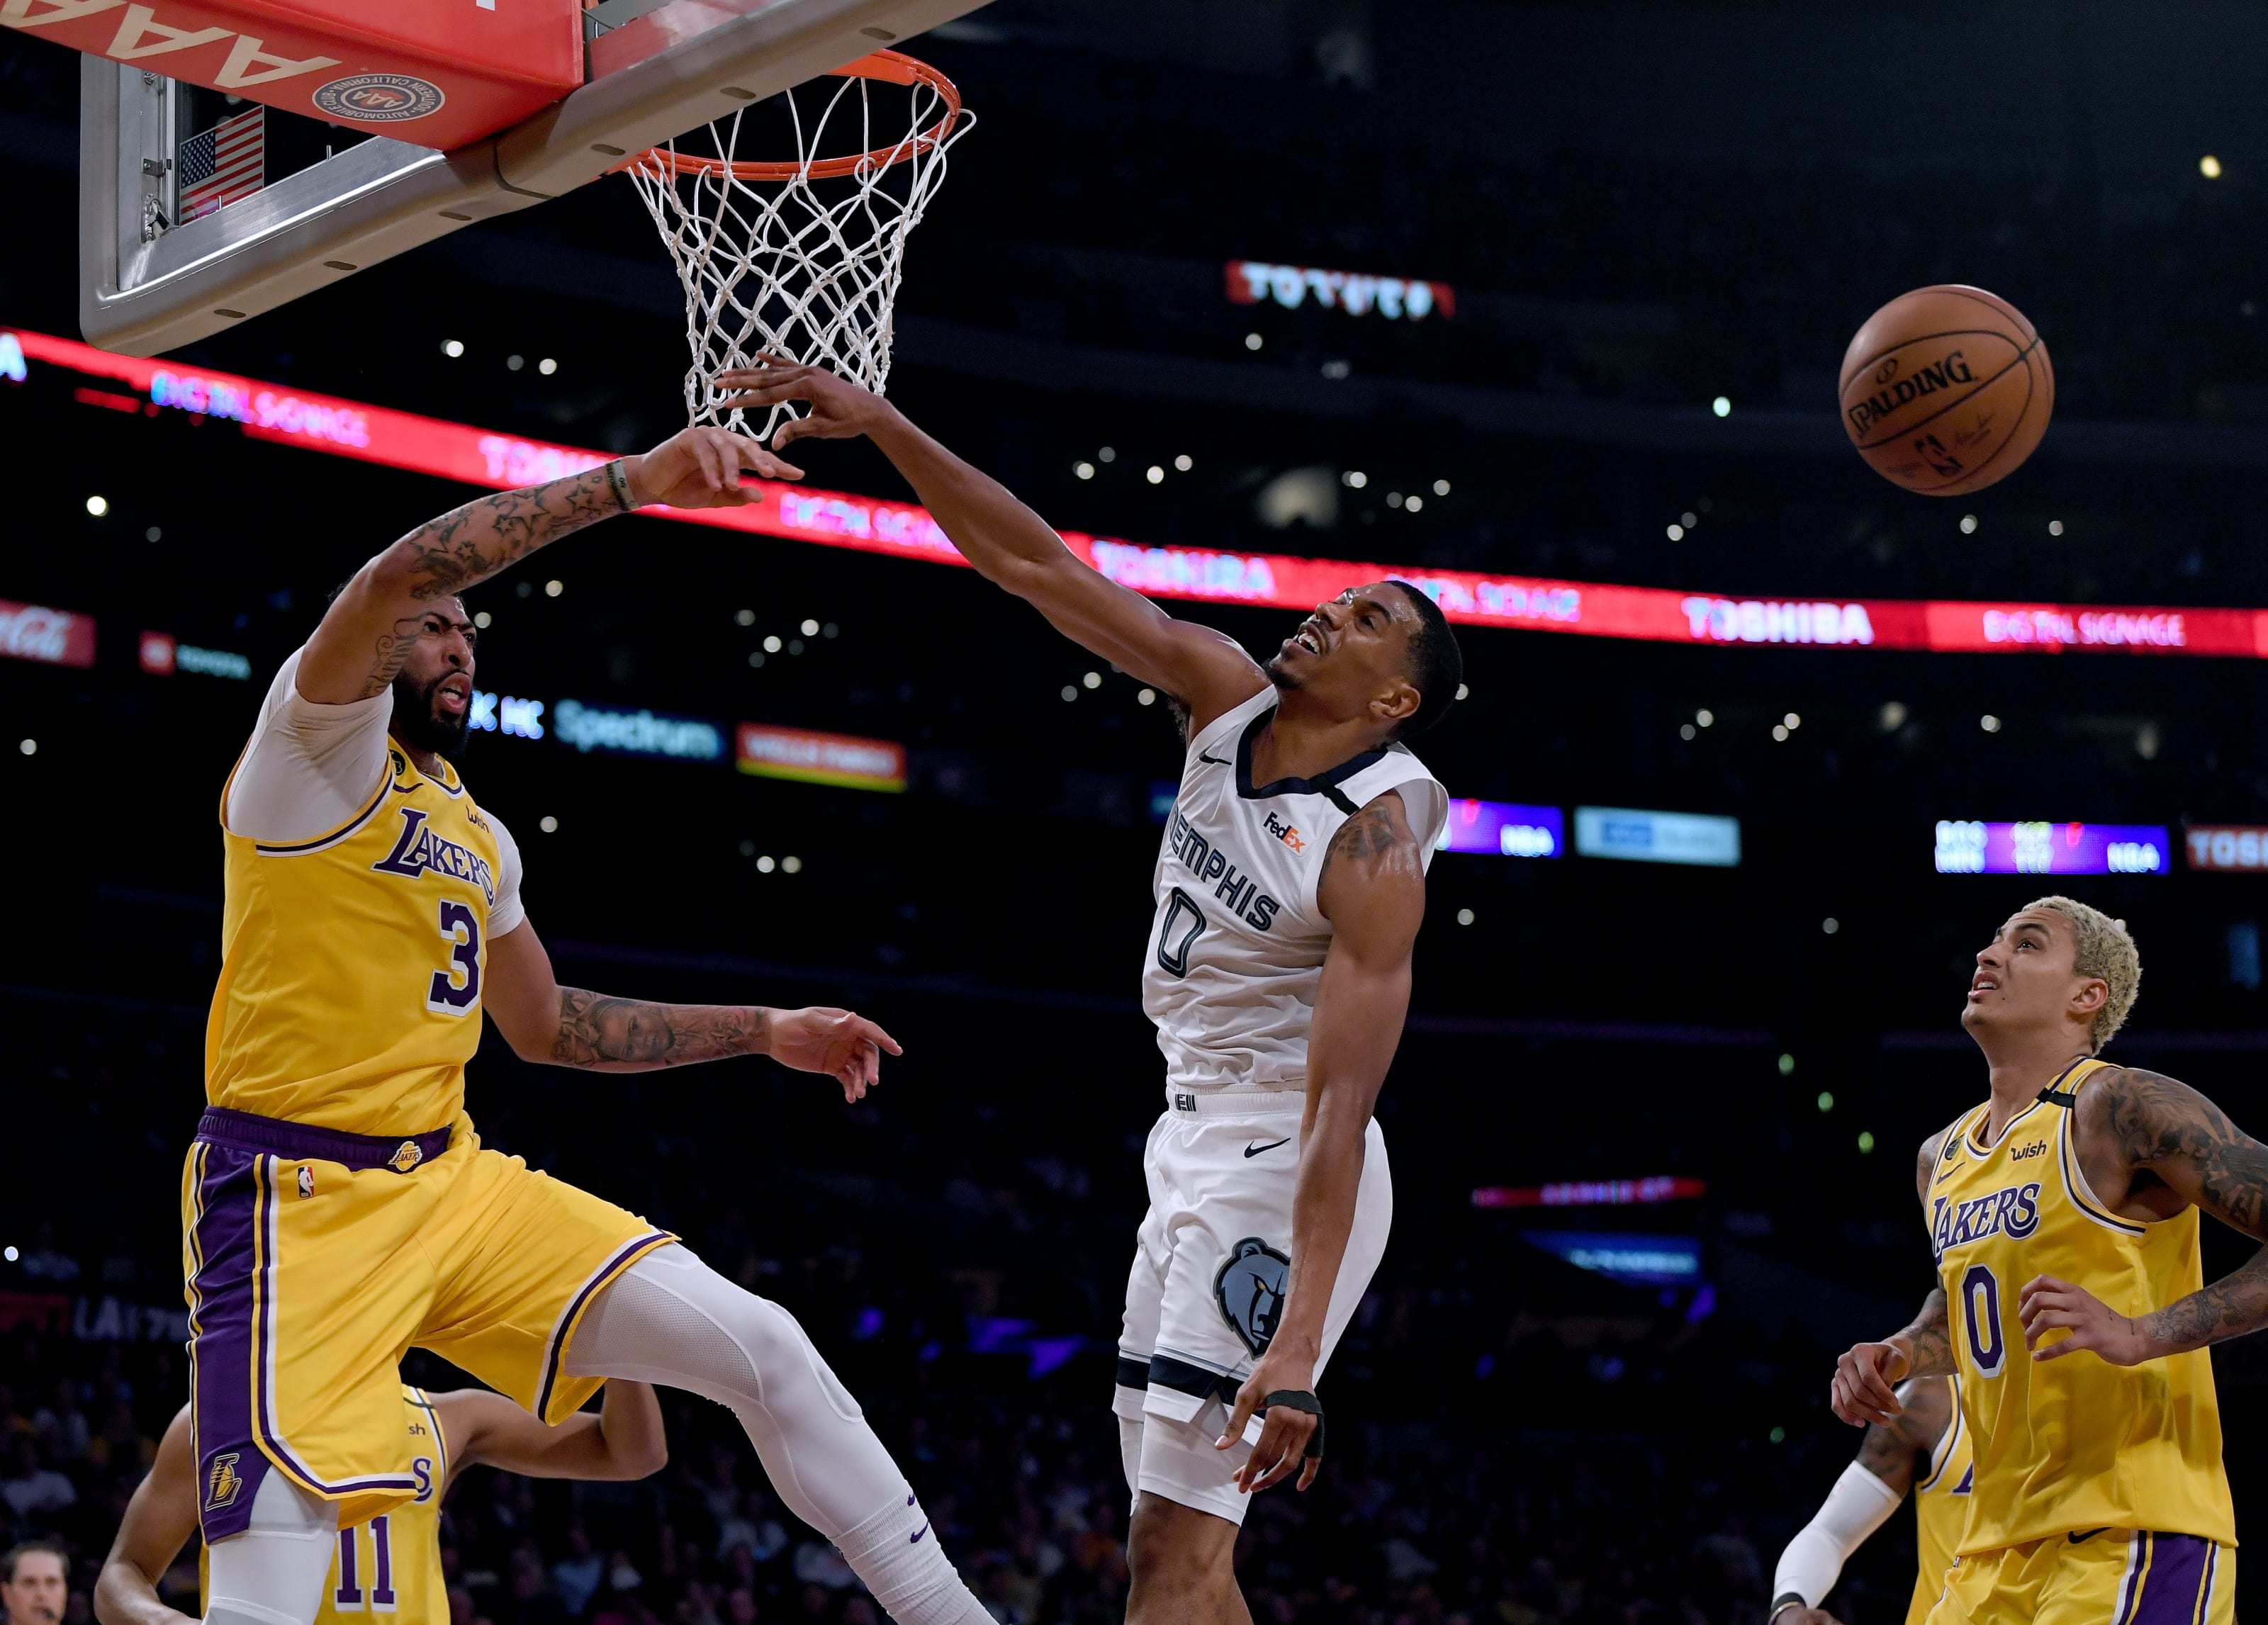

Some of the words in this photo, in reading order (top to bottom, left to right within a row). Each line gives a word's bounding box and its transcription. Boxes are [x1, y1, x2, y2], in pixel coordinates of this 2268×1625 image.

[329, 104, 410, 119] AUTOMOBILE
[352, 91, 404, 108] AAA
[1848, 350, 1974, 439] SPALDING
[1680, 597, 1875, 644] TOSHIBA
[464, 804, 489, 834] wish
[1263, 811, 1306, 854] FedEx
[2187, 829, 2268, 869] TOS
[369, 806, 495, 909] LAKERS
[427, 898, 483, 1017] 3
[1157, 887, 1207, 979] 0
[2011, 1140, 2047, 1162] wish
[1933, 1181, 2042, 1269] LAKERS
[1962, 1264, 2006, 1378] 0
[335, 1514, 398, 1613] 11
